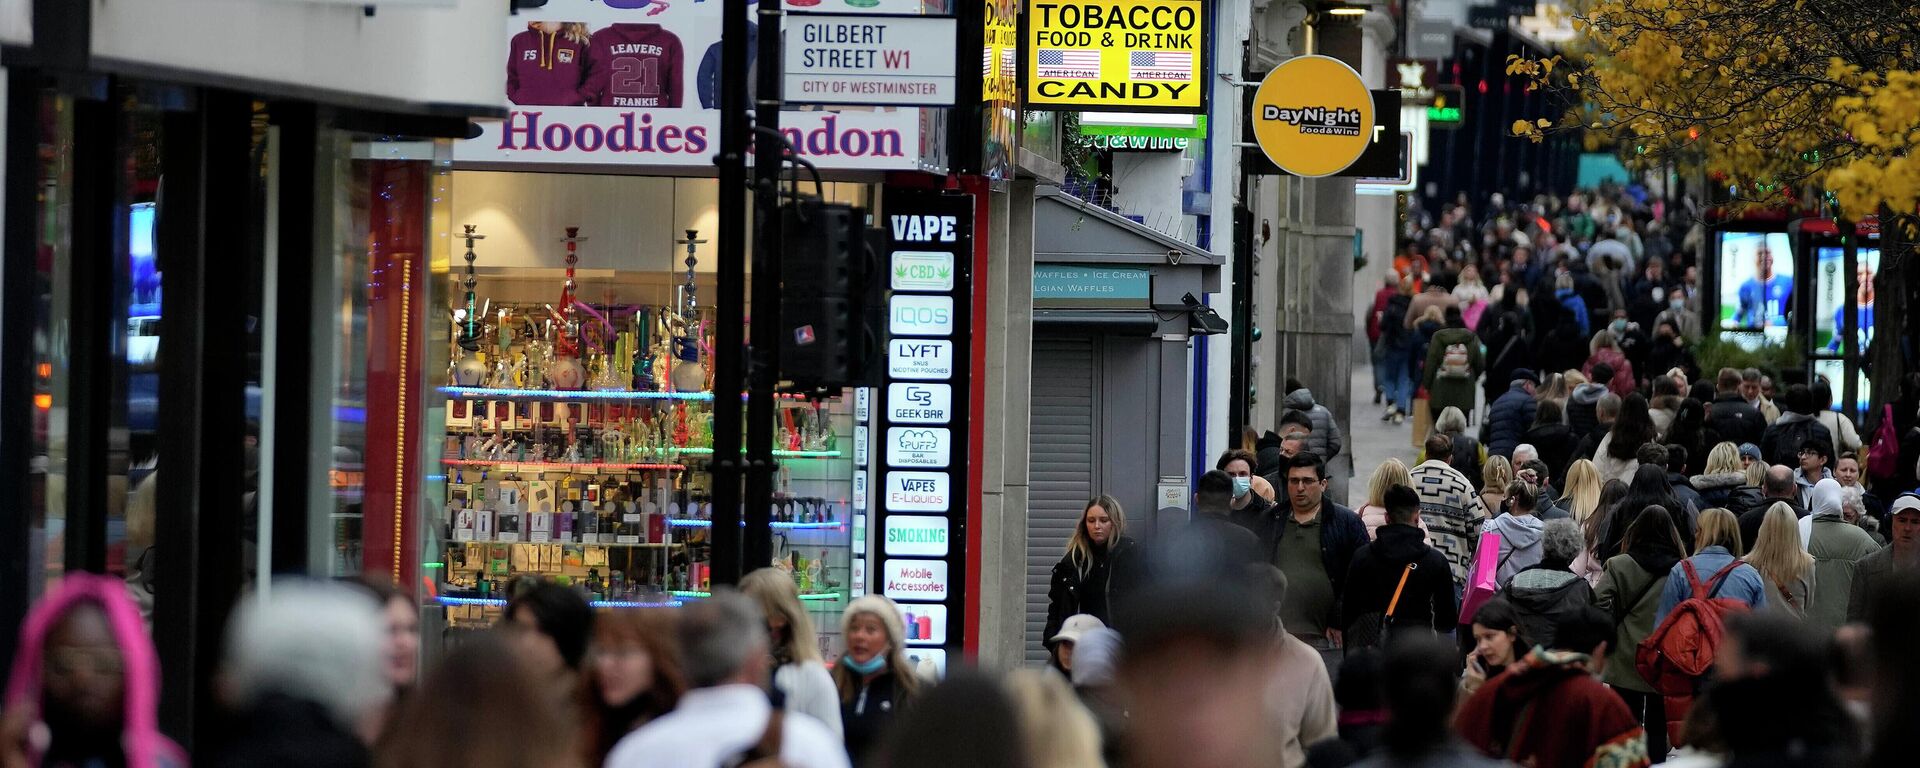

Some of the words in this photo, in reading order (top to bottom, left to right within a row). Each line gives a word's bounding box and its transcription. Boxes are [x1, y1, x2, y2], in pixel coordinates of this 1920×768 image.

[1036, 4, 1196, 31] TOBACCO
[804, 24, 887, 44] GILBERT
[1036, 31, 1092, 47] FOOD
[1101, 31, 1115, 47] &
[1125, 33, 1193, 49] DRINK
[523, 49, 537, 61] FS
[611, 43, 663, 56] LEAVERS
[803, 48, 877, 68] STREET
[883, 49, 911, 69] W1
[611, 56, 660, 95] 21
[1043, 69, 1095, 78] AMERICAN
[1136, 71, 1187, 79] AMERICAN
[803, 81, 829, 93] CITY
[833, 81, 847, 93] OF
[850, 81, 937, 95] WESTMINSTER
[1037, 80, 1191, 100] CANDY
[613, 96, 659, 107] FRANKIE
[1263, 105, 1361, 126] DayNight
[497, 111, 708, 154] Hoodies
[779, 115, 904, 157] ndon
[1300, 126, 1360, 136] Food&Wine
[890, 214, 957, 242] VAPE
[909, 264, 935, 279] CBD
[1033, 271, 1079, 279] WAFFLES
[1093, 271, 1110, 279] ICE
[1112, 271, 1147, 279] CREAM
[895, 306, 948, 326] IQOS
[899, 344, 943, 358] LYFT
[895, 408, 922, 418] GEEK
[923, 409, 943, 419] BAR
[904, 440, 932, 450] PUFF
[901, 478, 936, 492] VAPES
[888, 528, 945, 543] SMOKING
[900, 568, 933, 579] Mobile
[888, 580, 944, 592] Accessories
